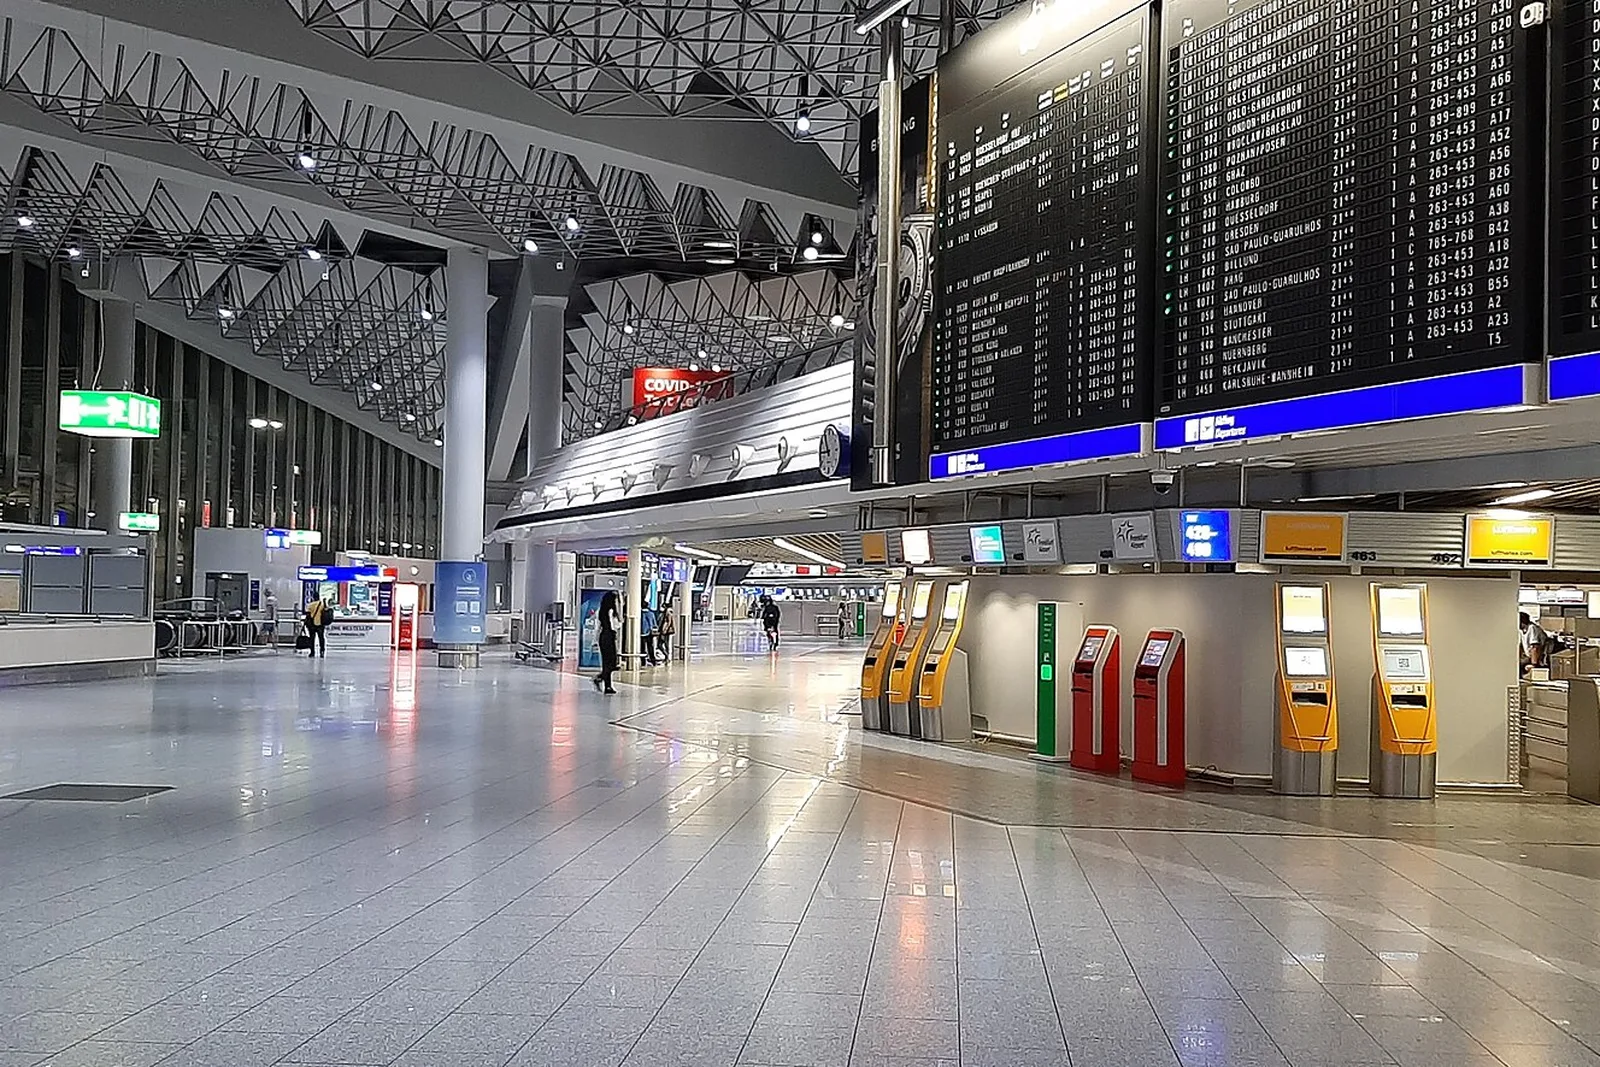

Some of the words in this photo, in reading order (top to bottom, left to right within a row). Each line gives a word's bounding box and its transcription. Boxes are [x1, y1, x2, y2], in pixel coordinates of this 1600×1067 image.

[1393, 8, 1398, 21] 1
[1411, 0, 1417, 13] A
[1393, 26, 1398, 38] 1
[1411, 17, 1417, 30] A
[1393, 43, 1397, 55] 1
[1410, 35, 1417, 48] A
[1430, 11, 1476, 39] 263-453
[1490, 0, 1511, 15] A30
[1393, 59, 1397, 72] 1
[1410, 52, 1417, 65] A
[1430, 29, 1475, 56] 263-453
[1490, 15, 1511, 33] B20
[1393, 77, 1397, 89] 1
[1410, 69, 1416, 82] A
[1430, 47, 1475, 74] 263-453
[1490, 36, 1503, 52] A5
[1392, 94, 1397, 106] 1
[1410, 86, 1416, 99] A
[1429, 65, 1475, 91] 263-453
[1490, 55, 1503, 70] A3
[1225, 176, 1259, 197] COLOMBO
[1392, 128, 1396, 140] 2
[1490, 91, 1503, 107] E2
[1226, 166, 1244, 182] GRAZ
[1392, 111, 1396, 123] 1
[1410, 104, 1416, 117] A
[1429, 84, 1475, 109] 263-453
[1490, 70, 1511, 88] A66
[1392, 145, 1396, 157] 1
[1409, 139, 1416, 151] A
[1429, 120, 1475, 144] 263-453
[1489, 107, 1510, 125] A17
[1225, 200, 1279, 227] DUESSELDORF
[1392, 162, 1396, 174] 1
[1409, 156, 1415, 169] A
[1429, 138, 1474, 162] 263-453
[1489, 126, 1510, 143] A52
[1225, 222, 1258, 241] DRESDEN
[1392, 179, 1396, 191] 1
[1409, 173, 1415, 186] A
[1429, 156, 1474, 179] 263-453
[1489, 144, 1510, 161] A56
[1224, 243, 1238, 256] SAO
[1244, 218, 1320, 251] PAULO-GUARULHOS
[1391, 196, 1395, 208] 1
[1409, 191, 1415, 203] A
[1428, 174, 1474, 197] 263-453
[1489, 163, 1510, 180] B26
[1224, 252, 1257, 271] BILLUND
[1391, 213, 1395, 225] 1
[1408, 208, 1415, 220] A
[1428, 192, 1474, 214] 263-453
[1489, 182, 1510, 198] A60
[1224, 272, 1242, 286] PRAG
[1391, 231, 1395, 242] 1
[1408, 225, 1415, 237] A
[1428, 210, 1474, 232] 263-453
[1489, 200, 1510, 217] A38
[1224, 288, 1237, 301] SAO
[1243, 267, 1320, 296] PAULO-GUARULHOS
[1391, 248, 1395, 259] 1
[1408, 242, 1414, 255] C
[1488, 219, 1509, 235] B42
[1391, 265, 1394, 276] 1
[1408, 260, 1414, 272] A
[1428, 246, 1473, 267] 263-453
[1488, 237, 1509, 253] A18
[1223, 311, 1267, 331] STUTTGART
[1391, 282, 1394, 293] 1
[1408, 277, 1414, 289] A
[1427, 264, 1473, 285] 263-453
[1488, 256, 1509, 272] A32
[1223, 326, 1271, 346] MANCHESTER
[1390, 299, 1394, 310] 1
[1407, 295, 1414, 307] A
[1427, 282, 1473, 303] 263-453
[1488, 275, 1509, 290] B55
[1223, 342, 1266, 361] NUERNBERG
[1331, 325, 1352, 339] 2150
[1390, 316, 1394, 327] 1
[1407, 312, 1414, 324] A
[1427, 301, 1473, 320] 263-453
[1488, 295, 1501, 308] A2
[1390, 333, 1394, 345] 1
[1407, 329, 1413, 341] A
[1427, 319, 1473, 338] 263-453
[1488, 312, 1509, 327] A23
[1390, 351, 1393, 362] 1
[1407, 347, 1413, 359] A
[1488, 331, 1501, 345] T5
[1351, 551, 1377, 561] 463
